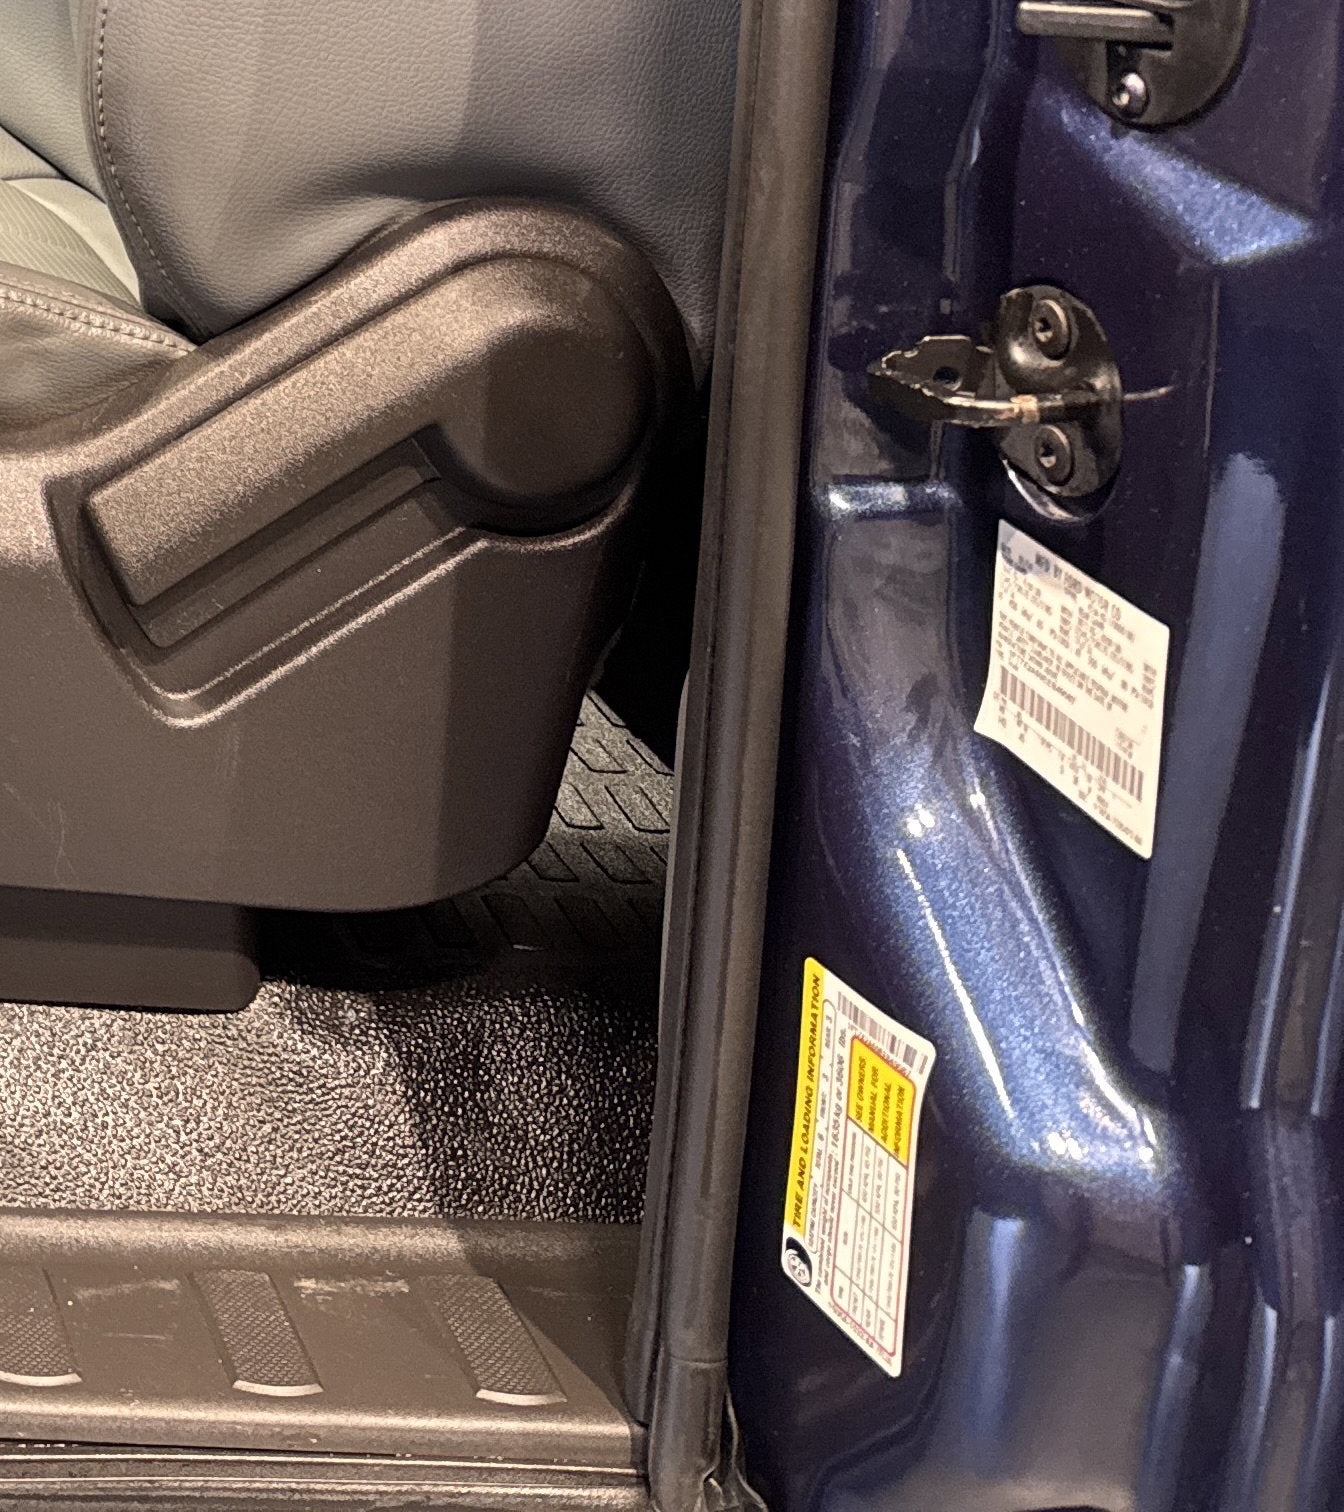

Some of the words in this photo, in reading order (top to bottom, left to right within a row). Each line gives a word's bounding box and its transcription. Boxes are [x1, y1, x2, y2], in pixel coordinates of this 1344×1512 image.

[806, 974, 820, 1082] INFORMATION
[800, 1085, 813, 1155] LOADING
[868, 1091, 877, 1134] MANUAL
[880, 1082, 892, 1144] ADDITIONAL
[892, 1086, 905, 1158] INFORMATION
[797, 1156, 806, 1191] AND
[792, 1192, 803, 1228] TIRE
